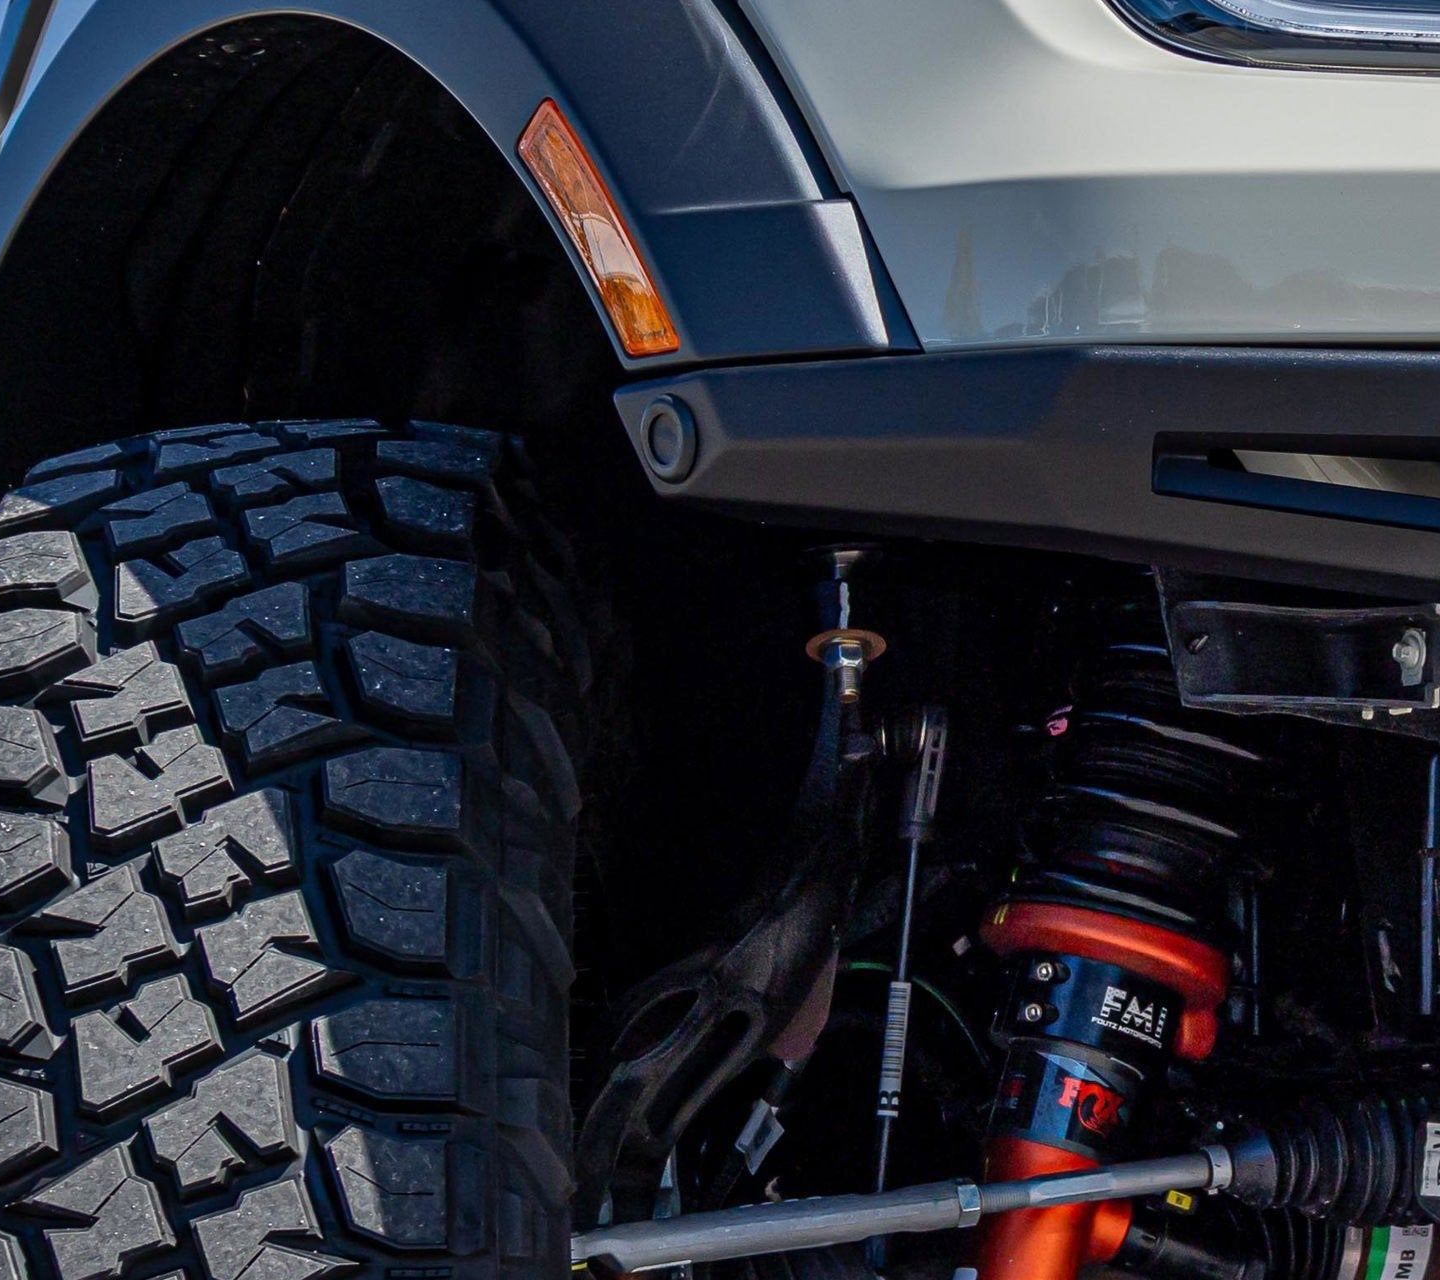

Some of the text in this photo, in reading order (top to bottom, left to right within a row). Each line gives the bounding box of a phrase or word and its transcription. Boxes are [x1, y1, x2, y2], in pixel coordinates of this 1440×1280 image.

[1100, 985, 1168, 1038] FMI
[1057, 1076, 1126, 1134] FOX
[1394, 1249, 1416, 1280] MB
